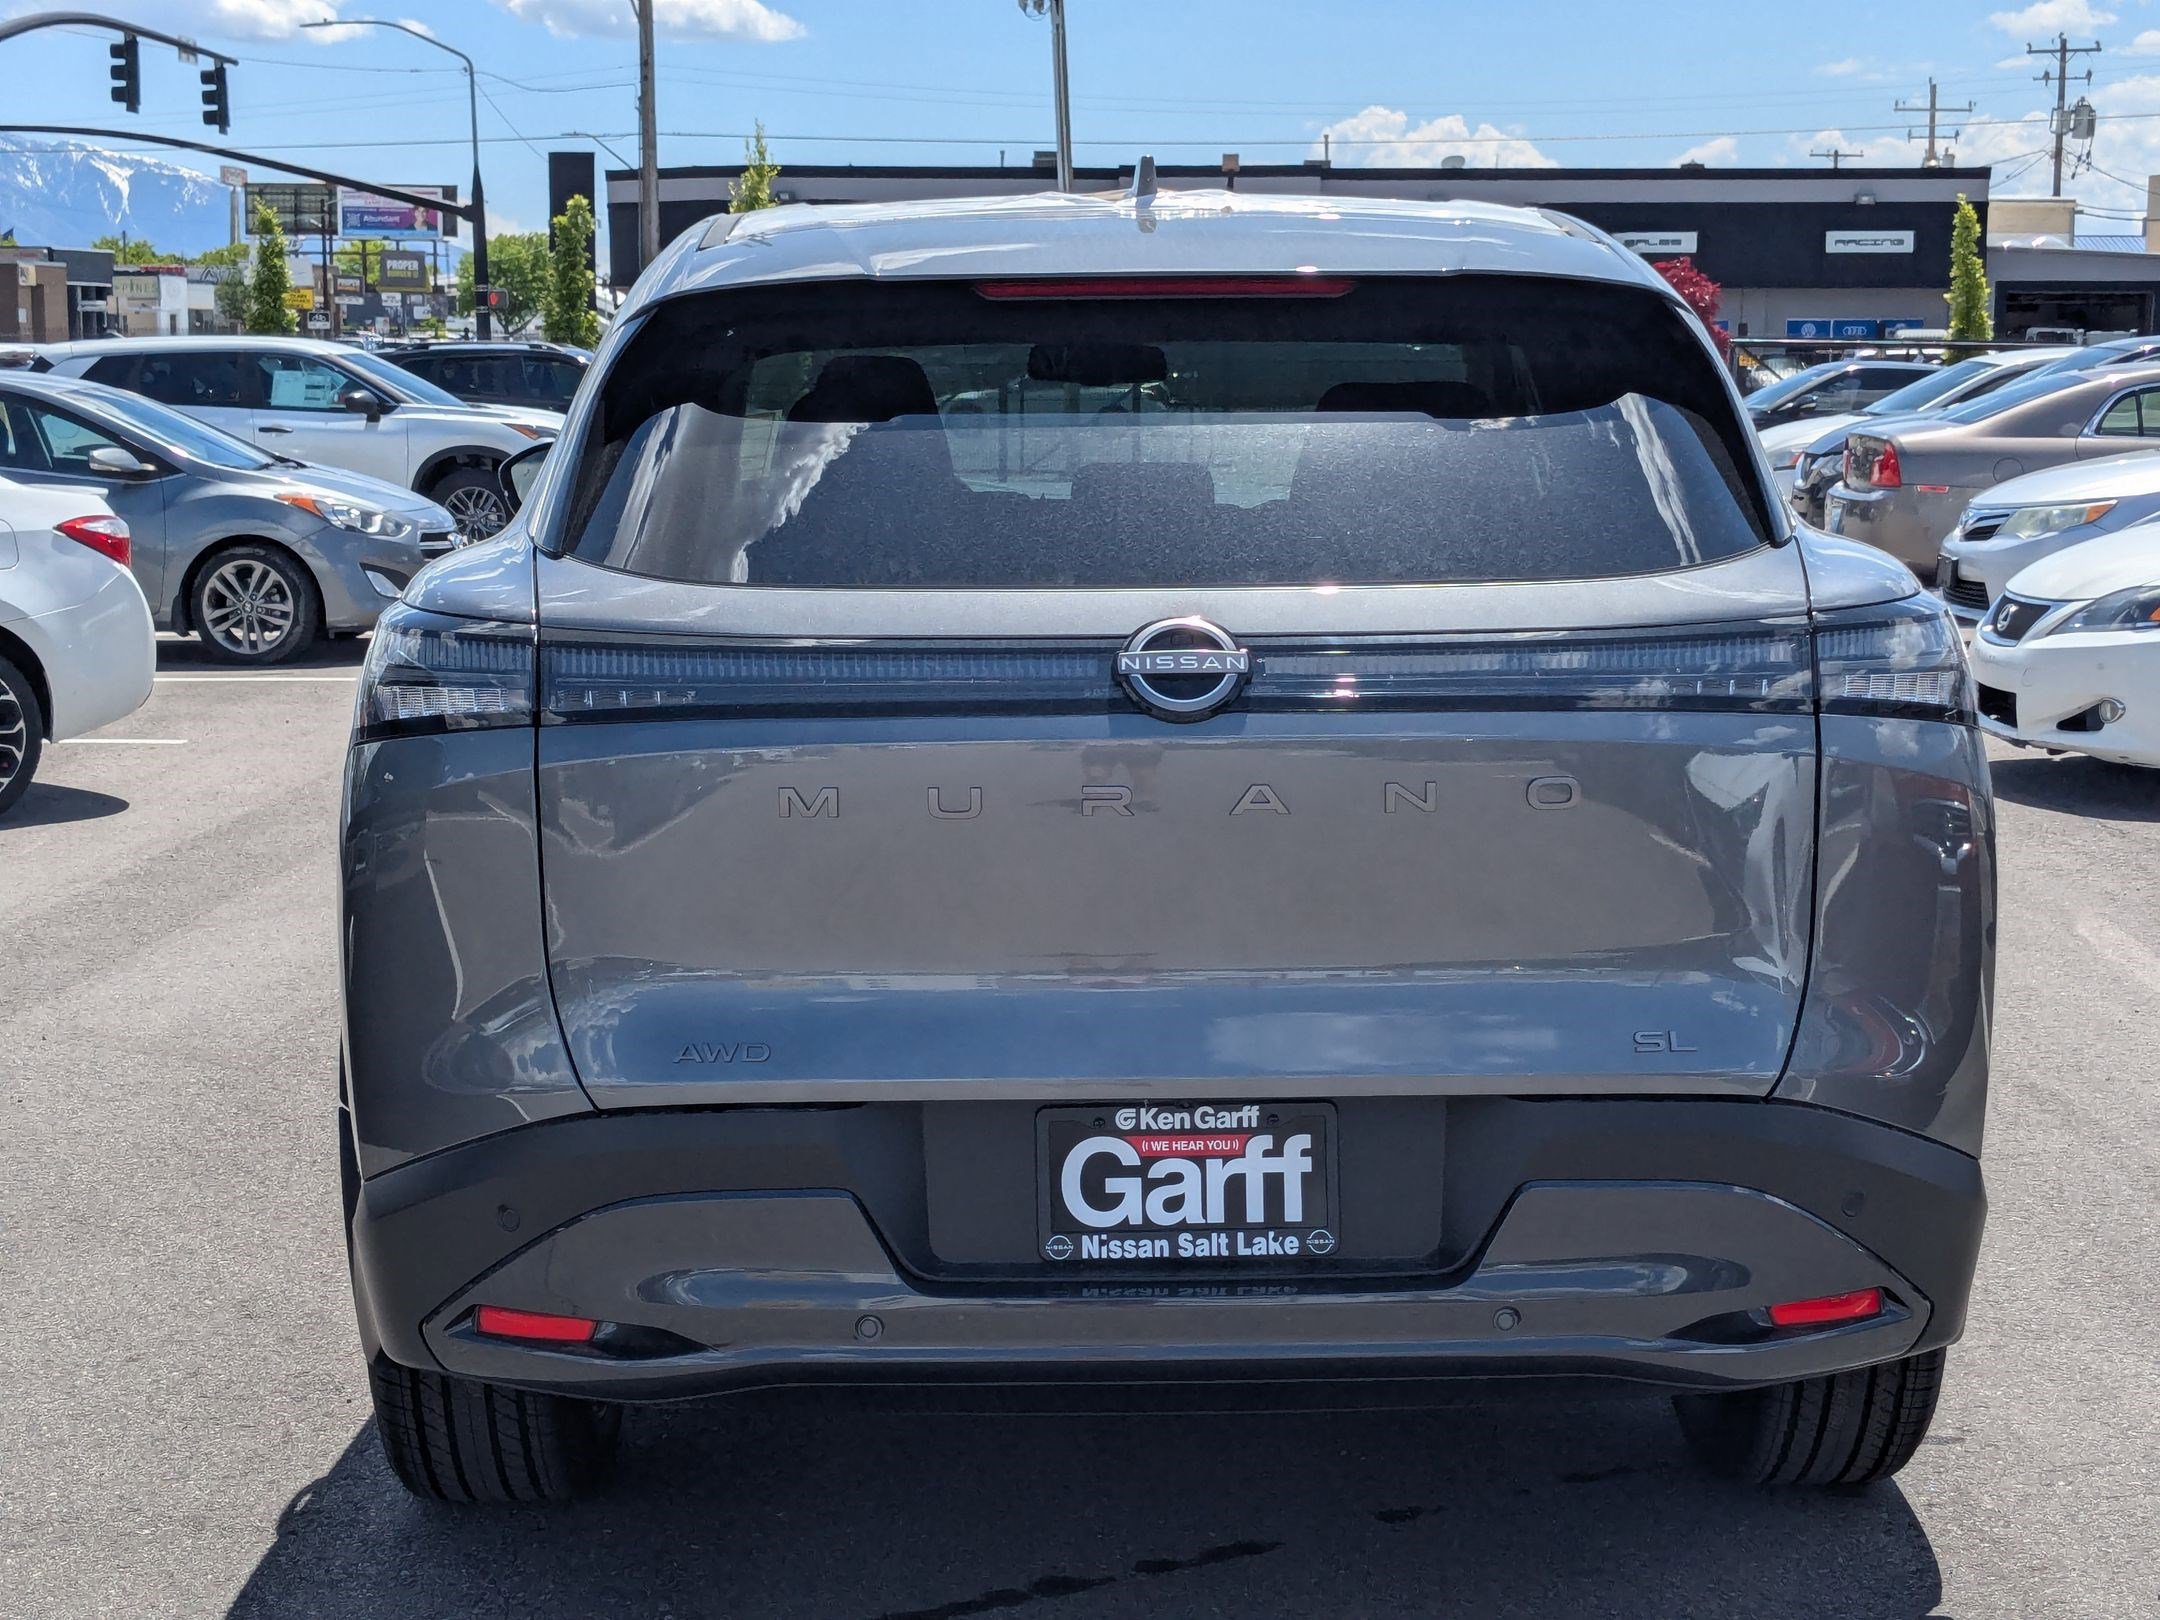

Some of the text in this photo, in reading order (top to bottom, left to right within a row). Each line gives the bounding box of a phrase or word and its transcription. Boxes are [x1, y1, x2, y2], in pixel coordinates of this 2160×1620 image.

[1834, 239, 1905, 247] RACING
[1121, 656, 1245, 670] NISSAN
[1632, 1030, 1698, 1053] SL
[672, 1043, 771, 1064] AWD
[1140, 1105, 1260, 1130] Ken Garff
[1151, 1139, 1231, 1151] WE HEAR YOU
[1061, 1134, 1313, 1228] Garff
[1046, 1243, 1074, 1251] NISSAN
[1081, 1231, 1299, 1259] Nissan Salt Lake
